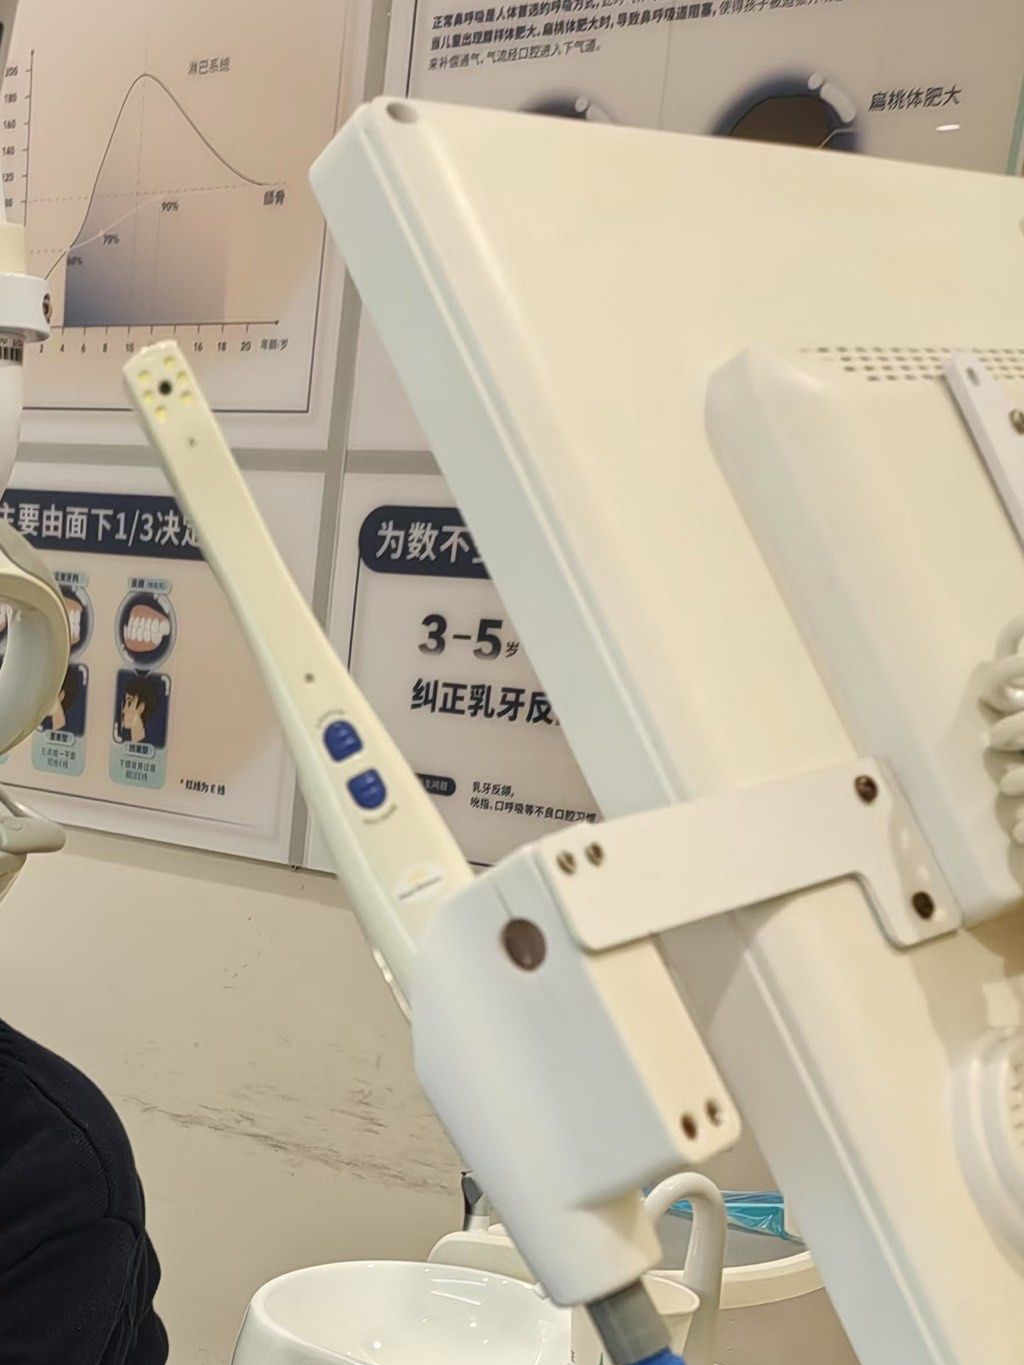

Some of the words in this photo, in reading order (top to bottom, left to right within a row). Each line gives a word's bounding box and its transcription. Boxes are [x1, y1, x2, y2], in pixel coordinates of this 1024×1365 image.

[188, 56, 230, 76] 淋巴系统
[868, 84, 962, 112] 扁桃体肥大
[161, 201, 180, 212] 90%
[240, 342, 251, 352] 20
[376, 519, 484, 564] 为数不
[410, 678, 562, 727] 纠正乳牙反
